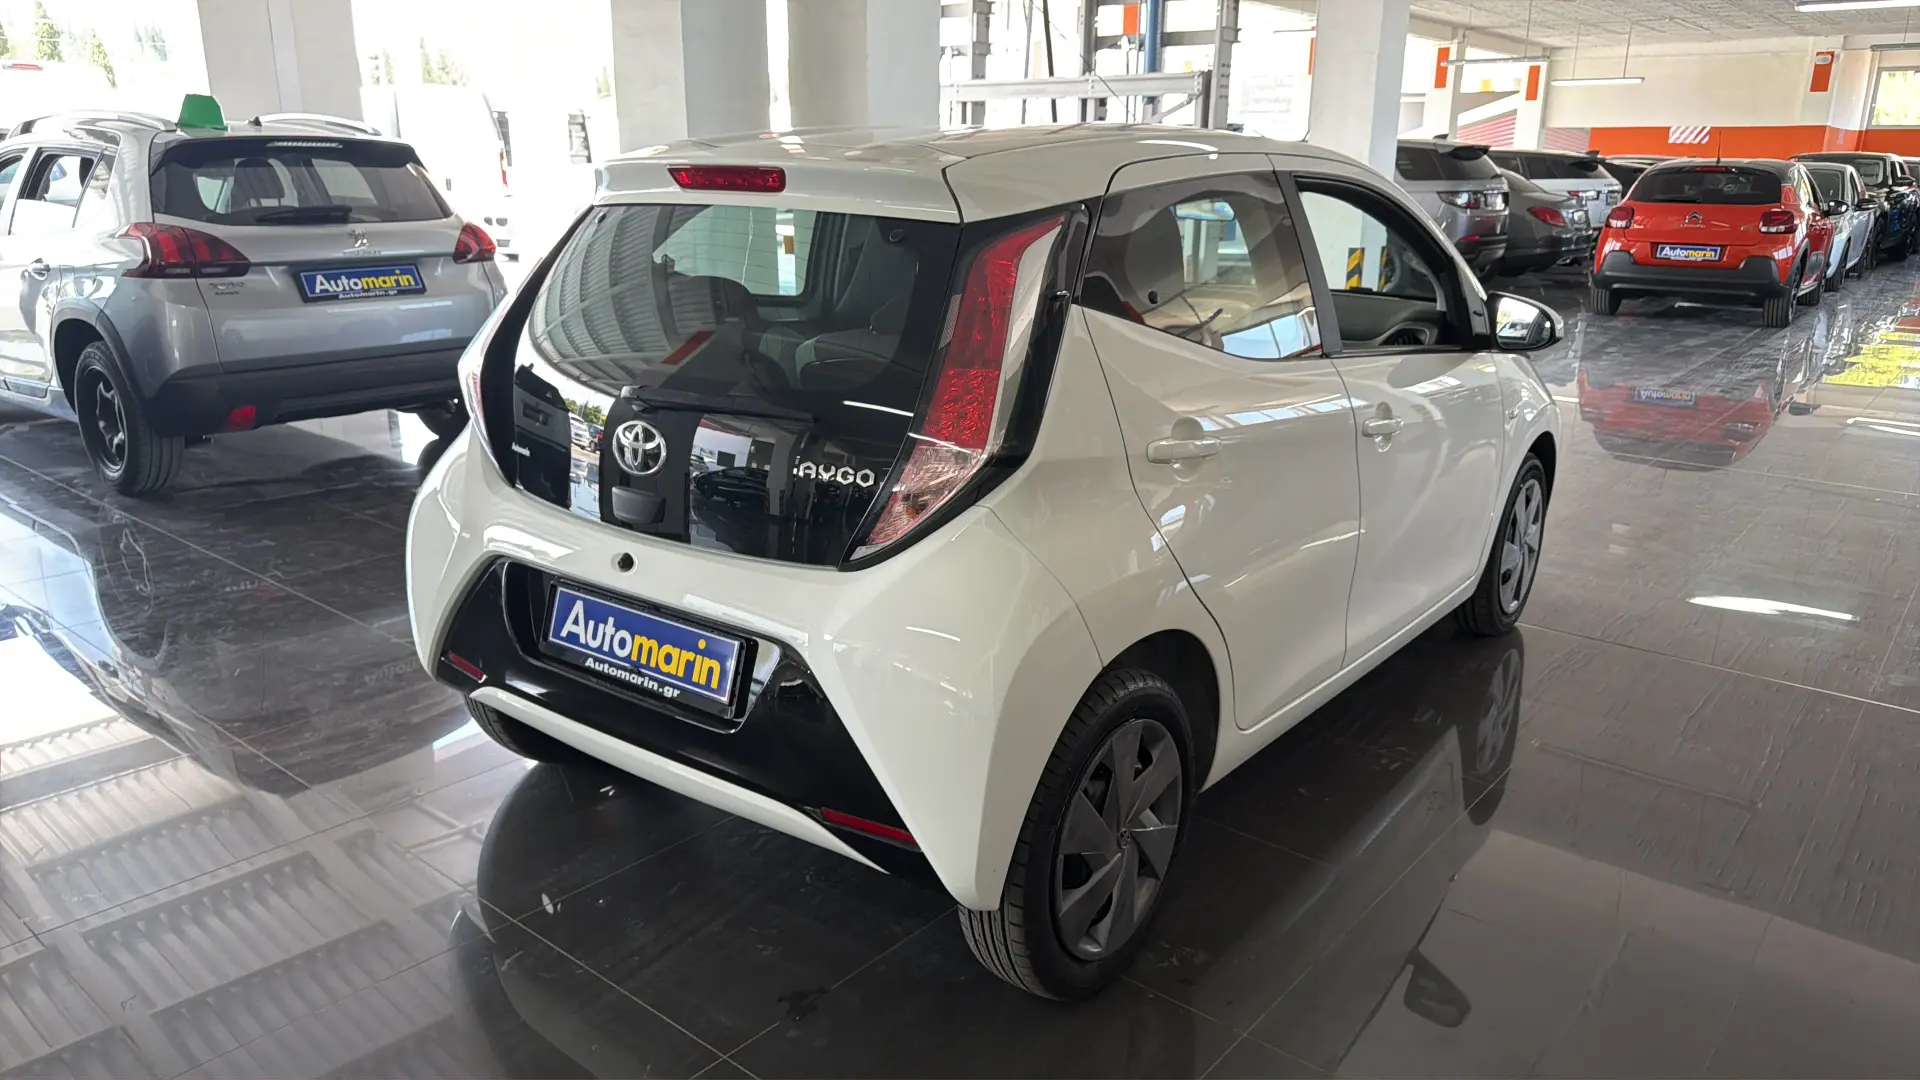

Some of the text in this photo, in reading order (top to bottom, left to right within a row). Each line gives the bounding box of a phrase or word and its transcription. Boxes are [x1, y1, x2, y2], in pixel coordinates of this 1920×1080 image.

[1661, 246, 1715, 258] Automarin
[315, 269, 415, 293] Automarin
[339, 289, 398, 300] Automarin.gr
[798, 460, 876, 488] AYGO
[560, 600, 721, 690] Automarin
[584, 657, 681, 698] Automarin.gr
